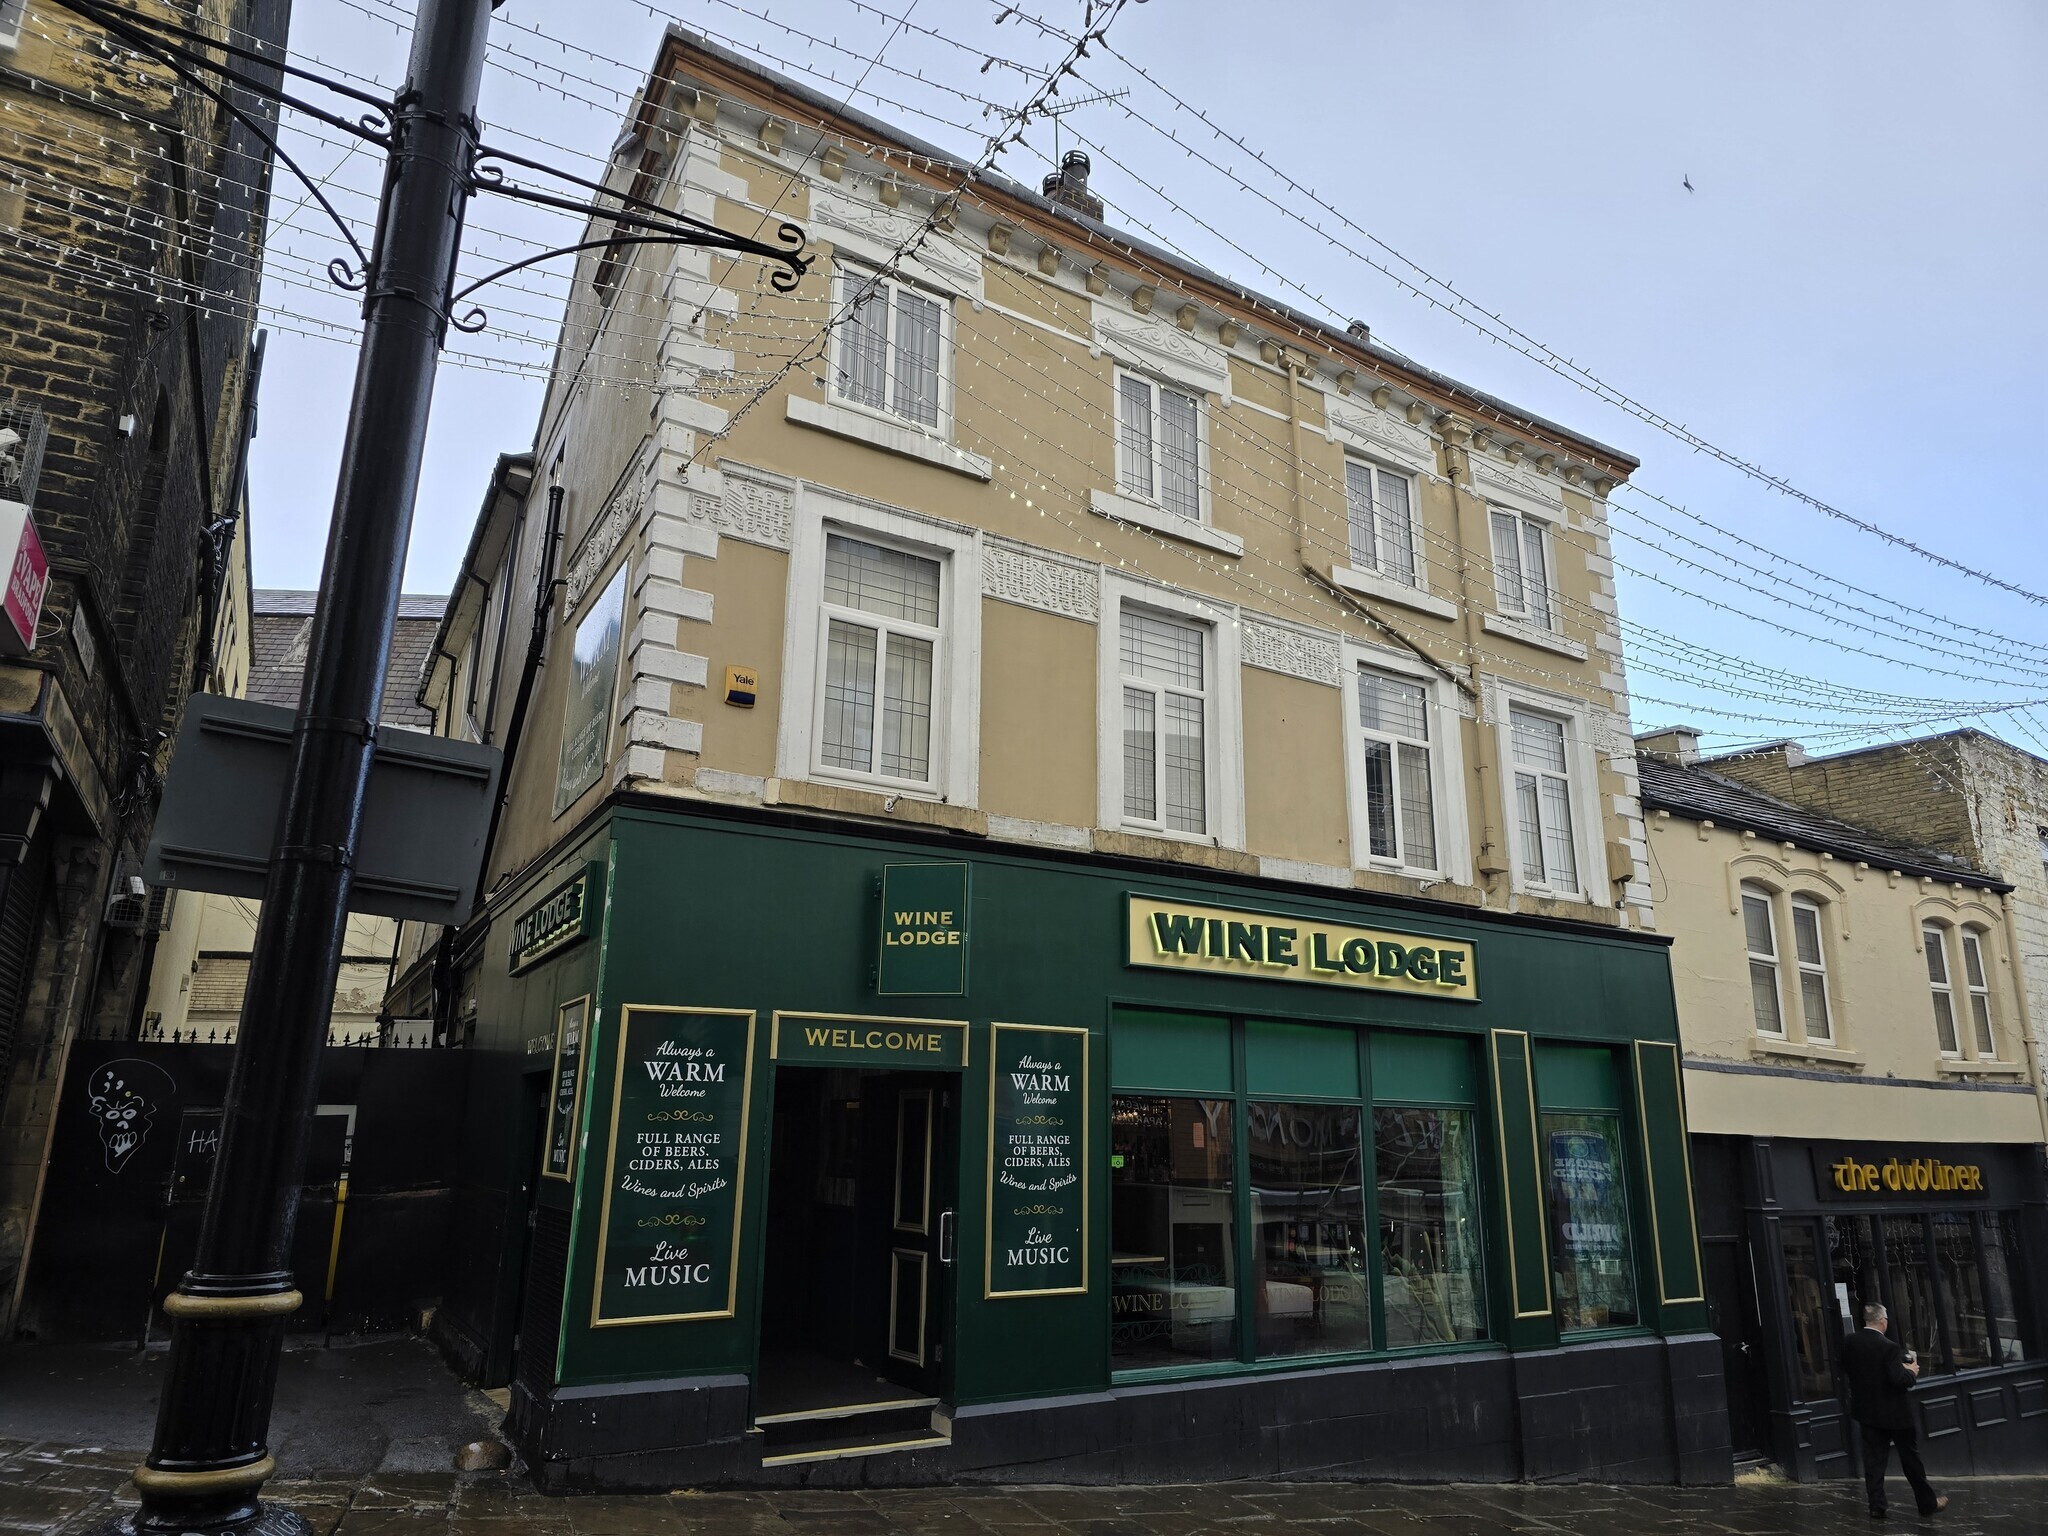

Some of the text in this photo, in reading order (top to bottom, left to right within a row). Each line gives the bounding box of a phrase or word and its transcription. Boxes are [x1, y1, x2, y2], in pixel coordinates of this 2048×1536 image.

[11, 574, 35, 627] BRADFORD
[734, 673, 754, 685] Yale
[509, 884, 579, 956] WINE LODGE
[894, 911, 953, 926] WINE
[886, 931, 961, 946] LODGE
[1151, 911, 1467, 987] WINE LODGE
[804, 1026, 942, 1052] WELCOME
[656, 1040, 715, 1059] Always a
[644, 1061, 725, 1083] WARM
[1018, 1055, 1053, 1071] Always
[659, 1083, 706, 1098] Welcome
[1011, 1073, 1070, 1092] WARM
[1023, 1093, 1057, 1105] Welcome
[637, 1133, 721, 1145] FULL RANGE
[1009, 1135, 1070, 1145] FULL RANGE
[642, 1146, 662, 1157] OF
[1013, 1146, 1063, 1157] OF BEERS,
[629, 1158, 719, 1172] CIDERS, ALES
[1004, 1157, 1071, 1168] CIDERS, ALES
[1000, 1170, 1077, 1192] Wines and Spirits
[1832, 1156, 1983, 1192] the dubliner
[621, 1174, 727, 1199] Wines and Spirits
[1024, 1226, 1052, 1245] Live
[650, 1240, 688, 1262] Live
[1007, 1246, 1069, 1266] MUSIC
[624, 1263, 710, 1287] MUSIC
[1112, 1293, 1164, 1313] WINE
